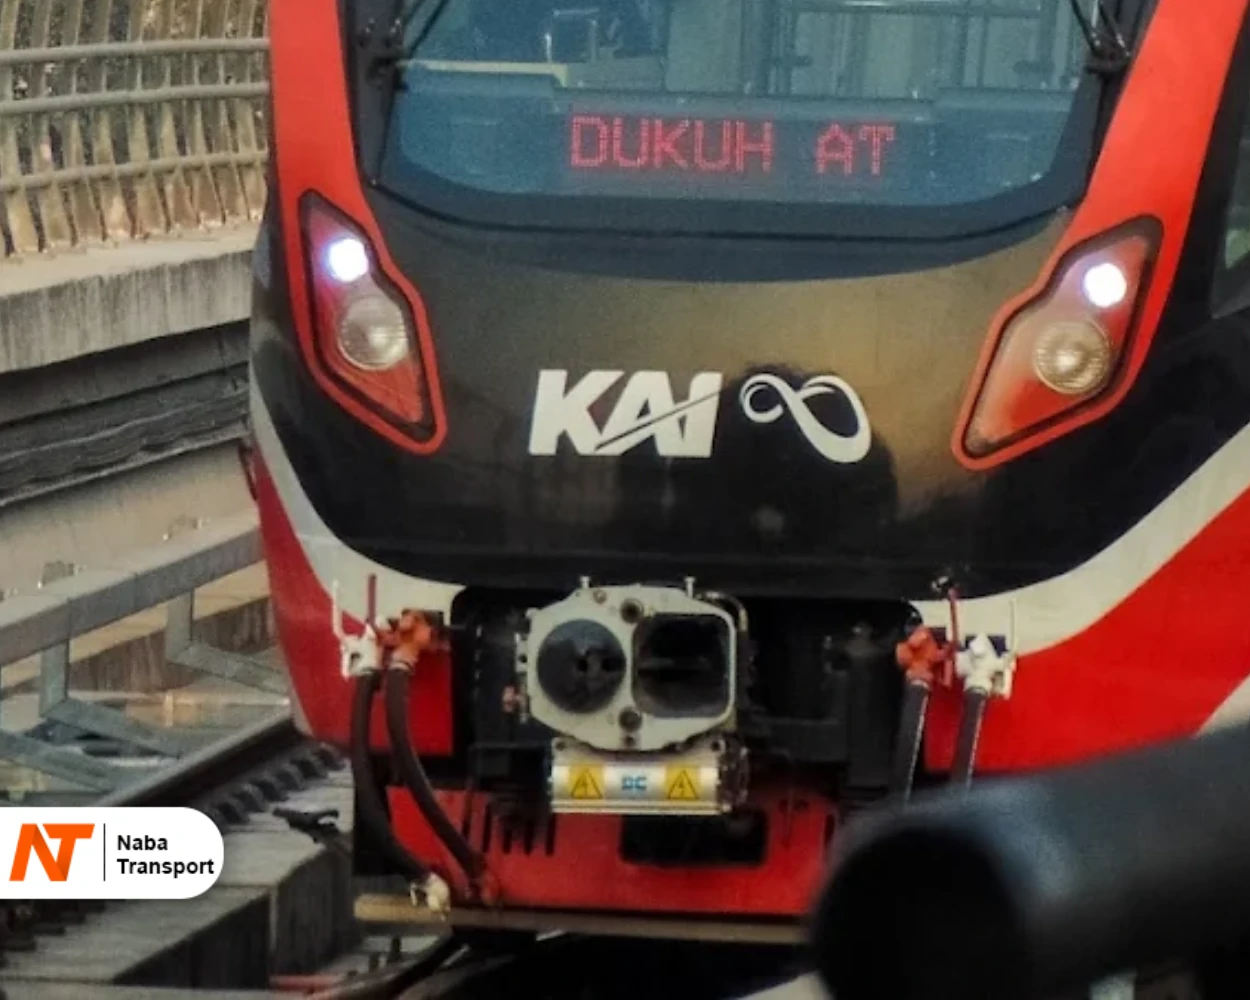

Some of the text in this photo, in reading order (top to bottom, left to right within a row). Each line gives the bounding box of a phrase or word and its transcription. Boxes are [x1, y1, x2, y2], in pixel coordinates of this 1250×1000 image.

[571, 115, 895, 175] DUKUH AT
[528, 369, 722, 457] KAI
[622, 776, 647, 791] DC
